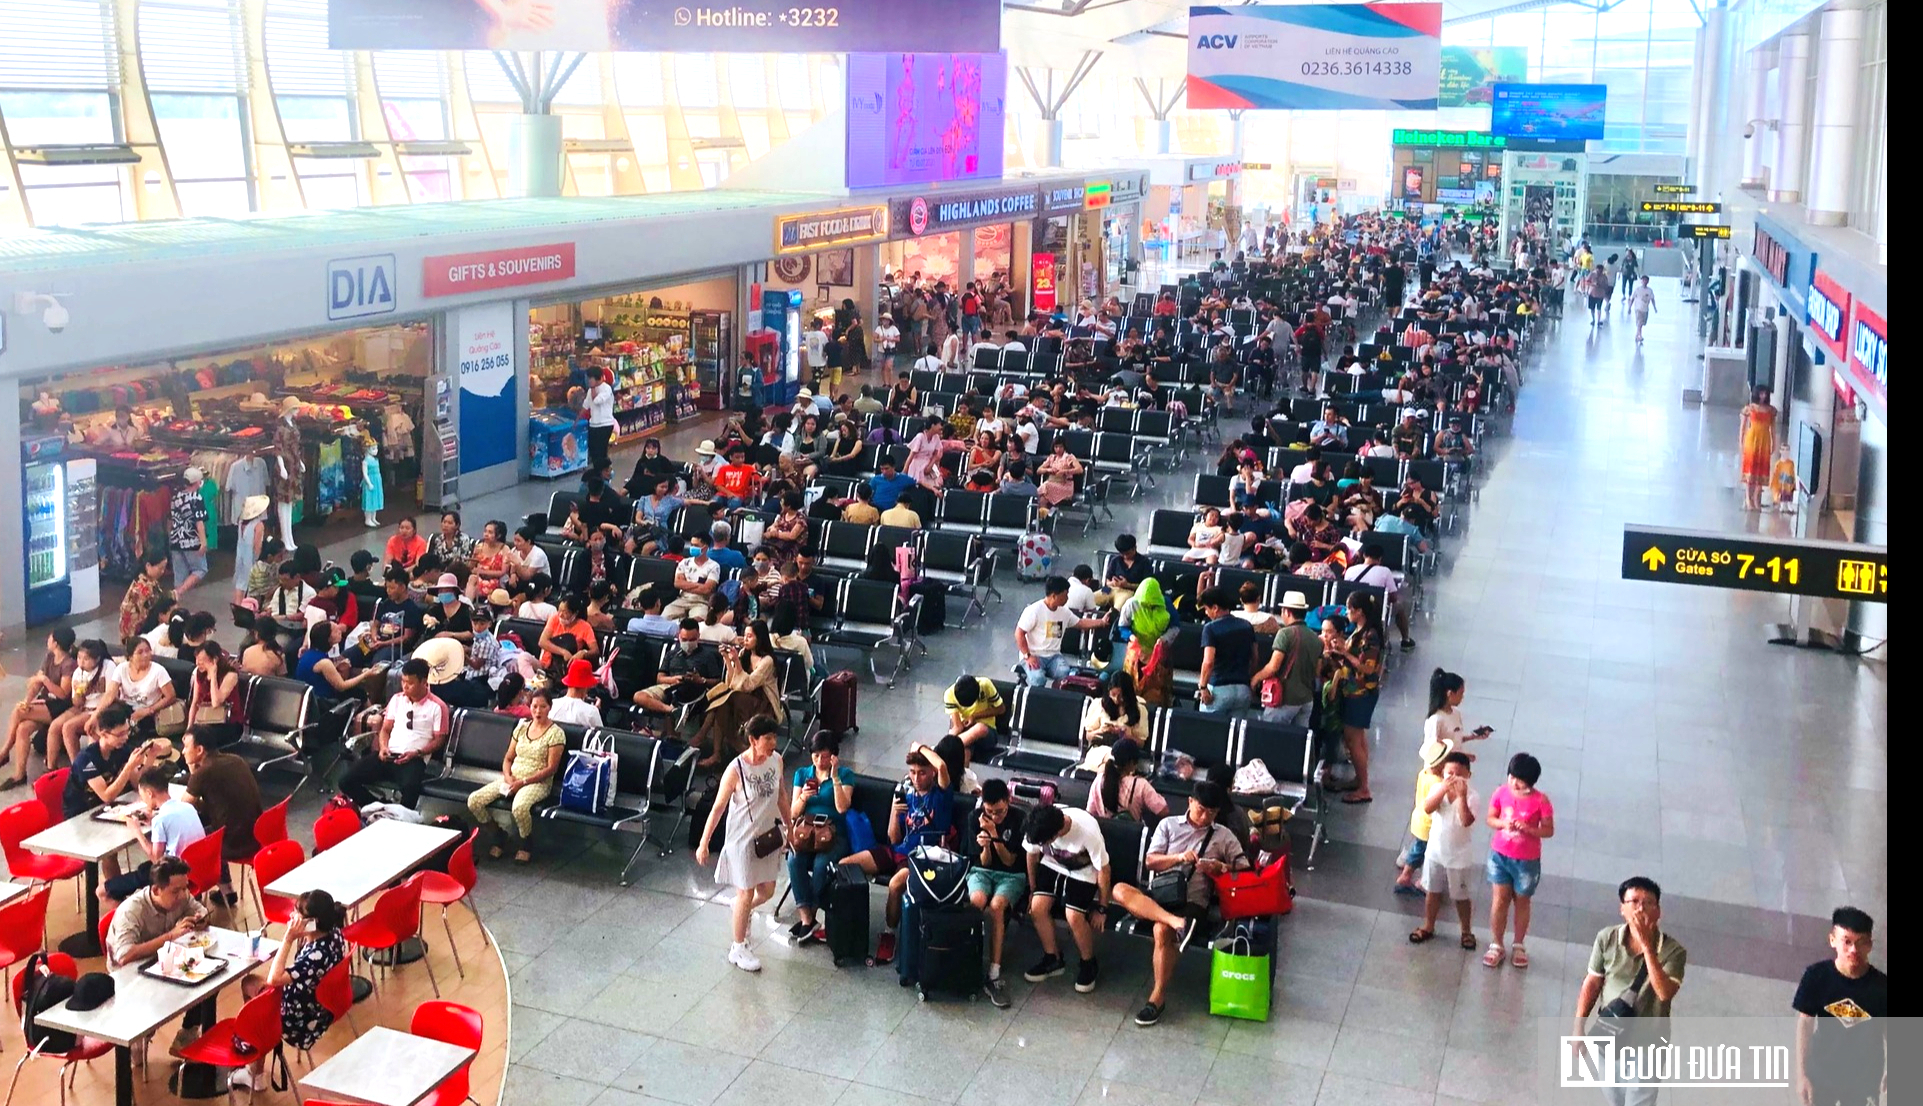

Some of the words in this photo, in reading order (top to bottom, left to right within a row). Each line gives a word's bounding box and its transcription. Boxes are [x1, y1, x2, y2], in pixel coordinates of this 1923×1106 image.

[696, 7, 772, 27] Hotline:
[1196, 34, 1238, 49] ACV
[1301, 61, 1412, 76] 0236.3614338
[1394, 129, 1465, 144] Heineken
[1467, 130, 1493, 145] Bar
[939, 198, 1000, 222] HIGHLANDS
[1001, 194, 1035, 213] COFFEE
[799, 221, 820, 239] FAST
[820, 219, 843, 237] FOOD
[448, 263, 486, 282] GIFTS
[488, 262, 497, 278] &
[498, 254, 562, 277] SOUVENIRS
[331, 265, 392, 310] DIA
[1854, 320, 1878, 375] LUCKY
[460, 360, 480, 375] 0916
[480, 357, 495, 371] 256
[495, 353, 510, 368] 055
[1675, 562, 1714, 577] Gates
[1676, 547, 1708, 563] CỬA
[1736, 553, 1800, 585] 7-11
[1222, 969, 1256, 982] crocs
